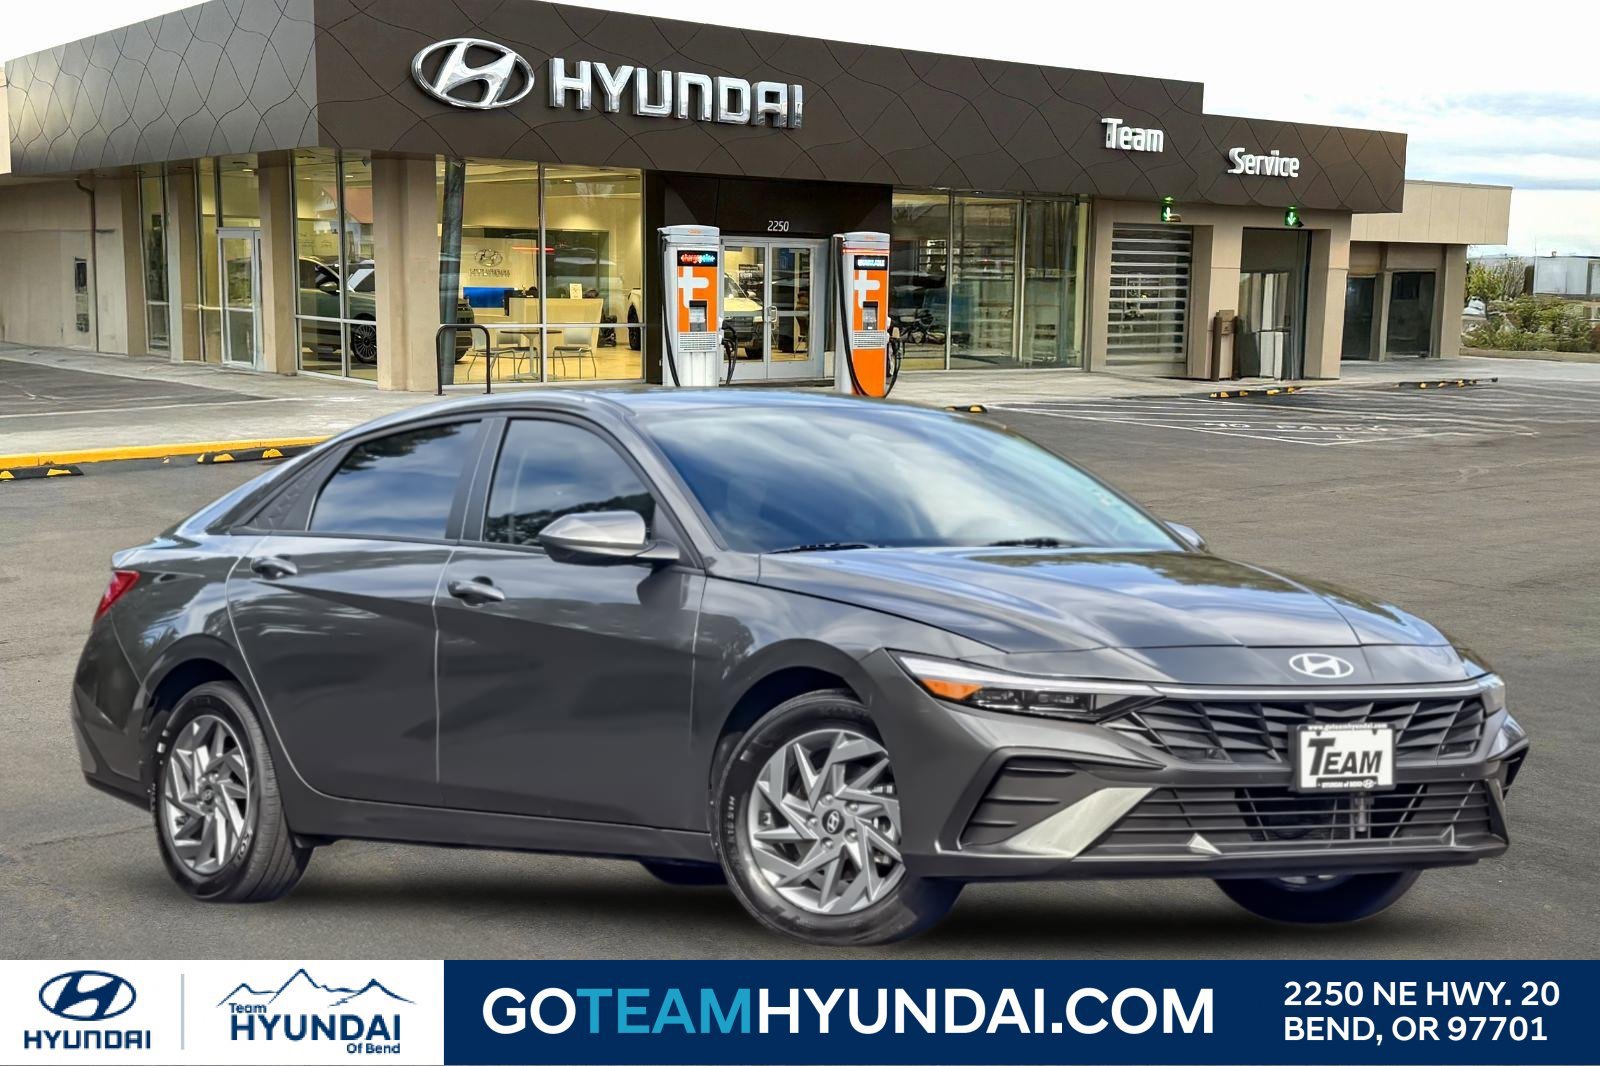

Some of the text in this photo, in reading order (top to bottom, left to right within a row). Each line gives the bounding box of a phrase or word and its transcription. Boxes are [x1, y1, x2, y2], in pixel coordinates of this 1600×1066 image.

[549, 57, 804, 128] HYUNDAI
[1102, 118, 1164, 152] Team
[1228, 147, 1299, 177] Service
[767, 220, 790, 232] 2250
